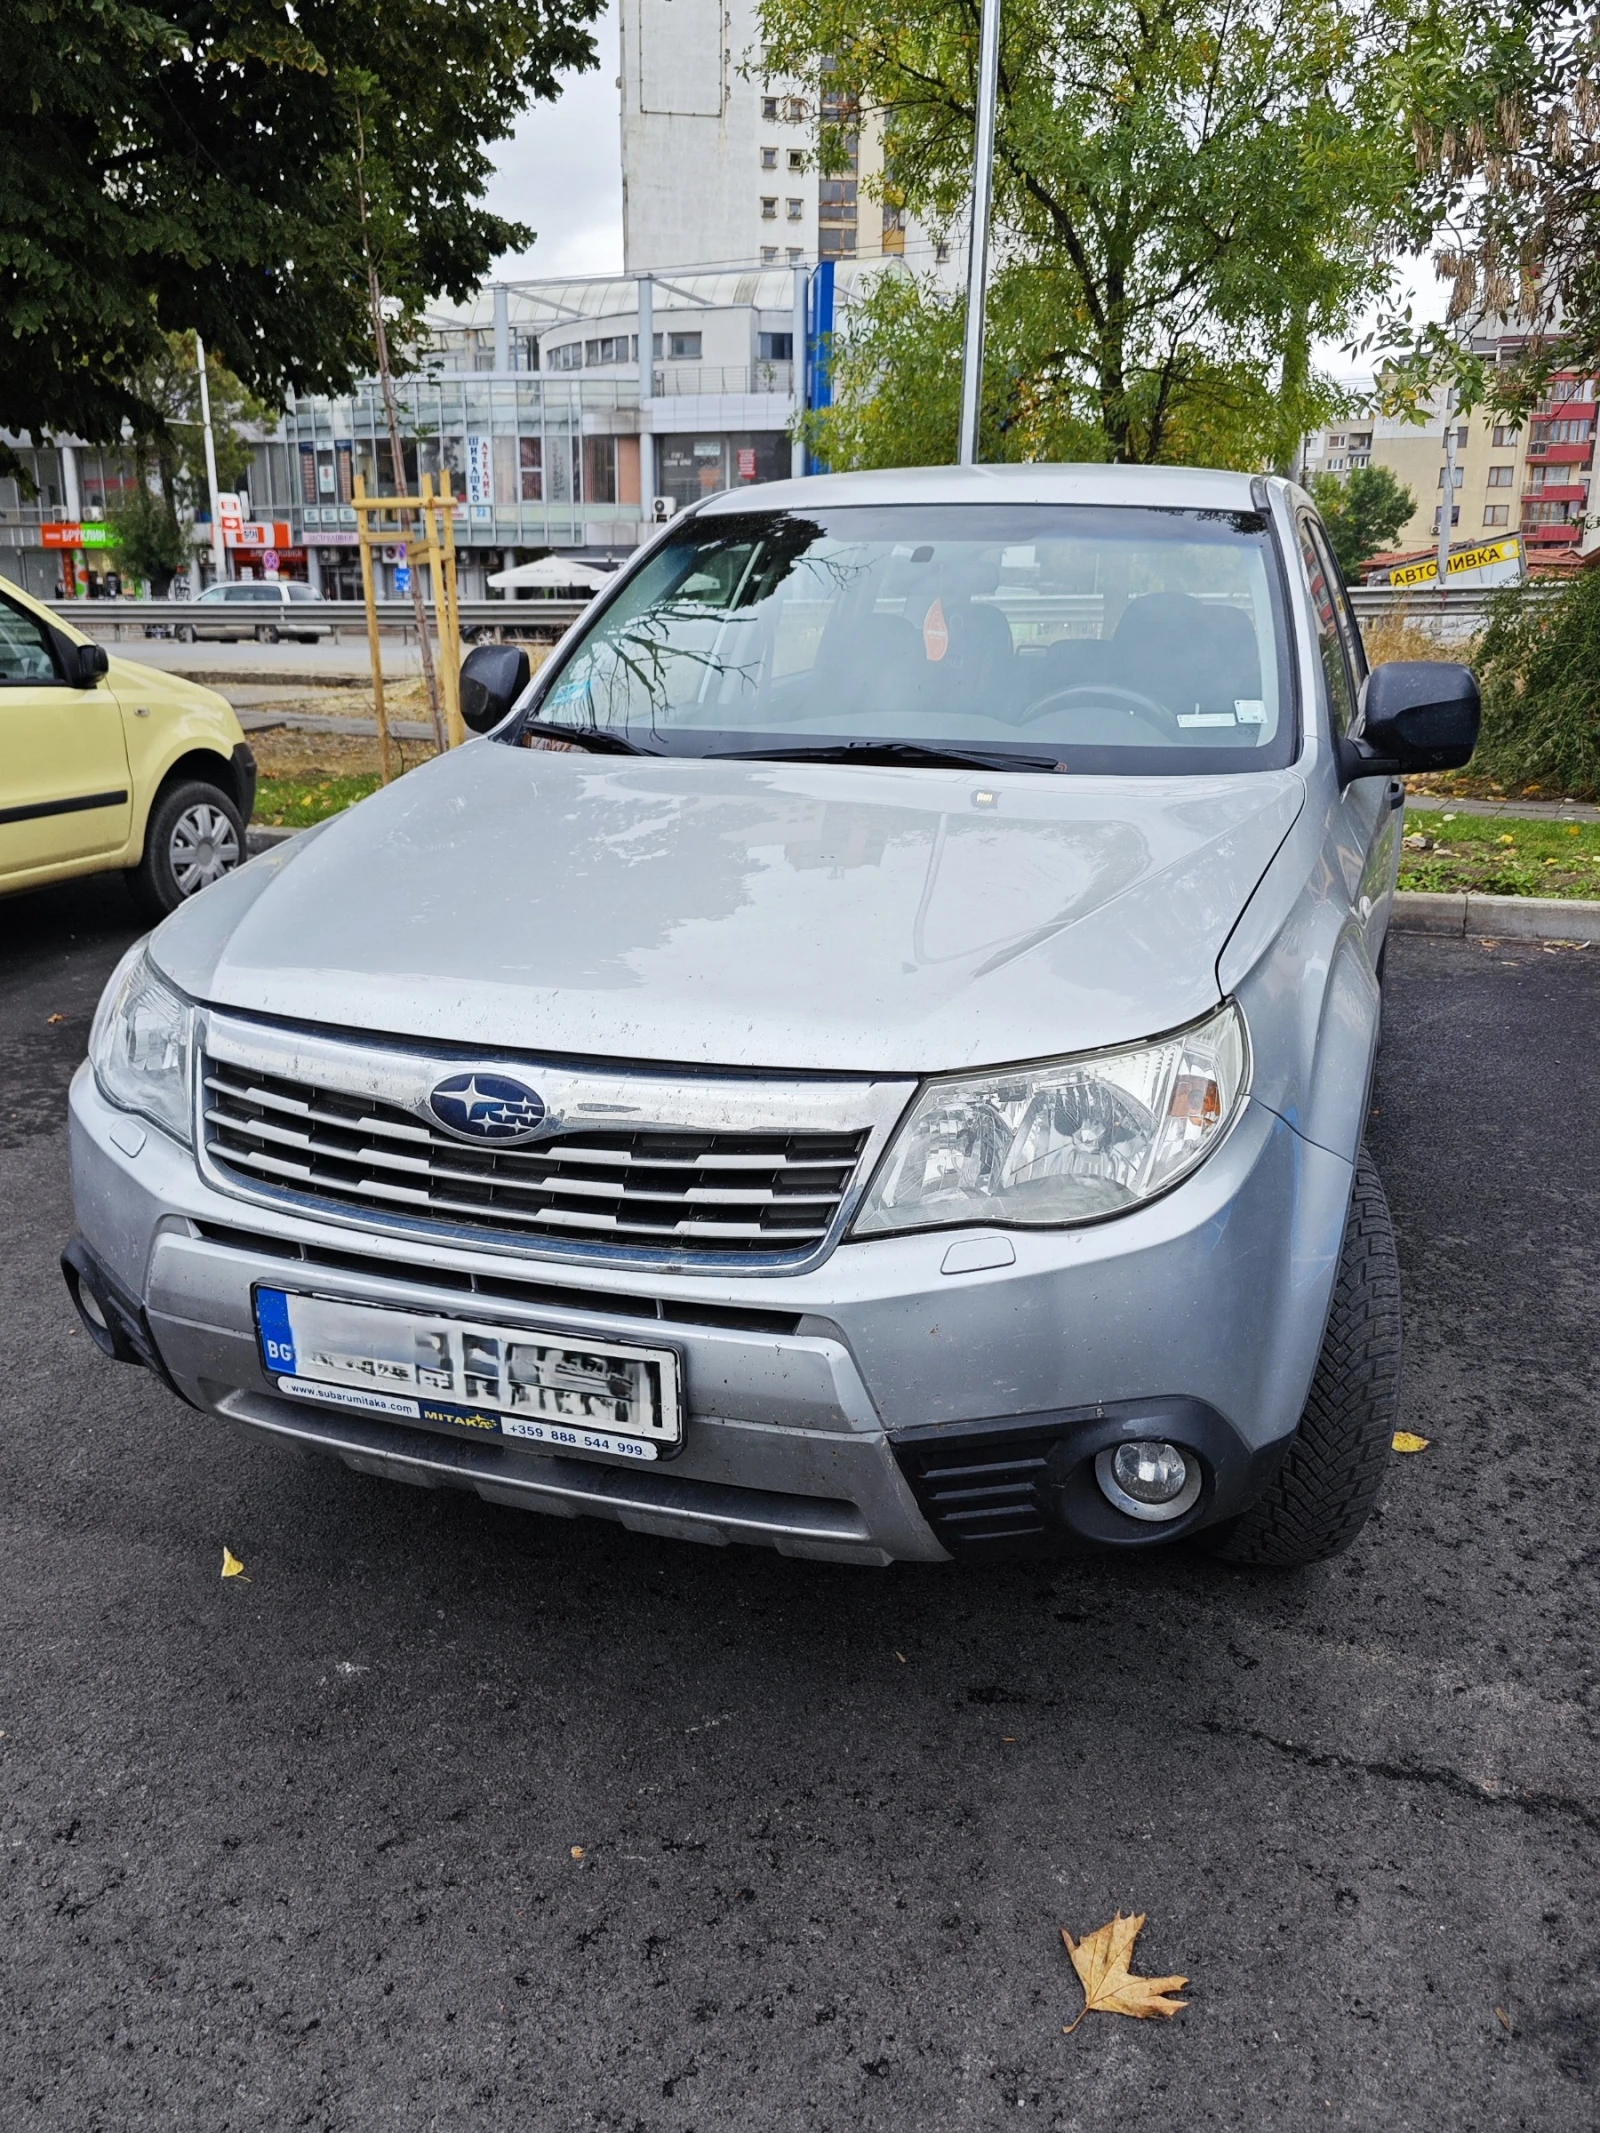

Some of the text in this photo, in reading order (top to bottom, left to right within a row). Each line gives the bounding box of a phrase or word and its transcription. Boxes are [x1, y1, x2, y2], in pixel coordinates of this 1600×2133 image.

[468, 436, 480, 502] ШИВАШКО
[482, 442, 490, 498] АТЕЛИЕ
[267, 1339, 292, 1362] BG
[291, 1384, 413, 1414] www.subarumitaka.com
[424, 1410, 493, 1430] MITAKA
[509, 1424, 643, 1457] +359 888 544 999
